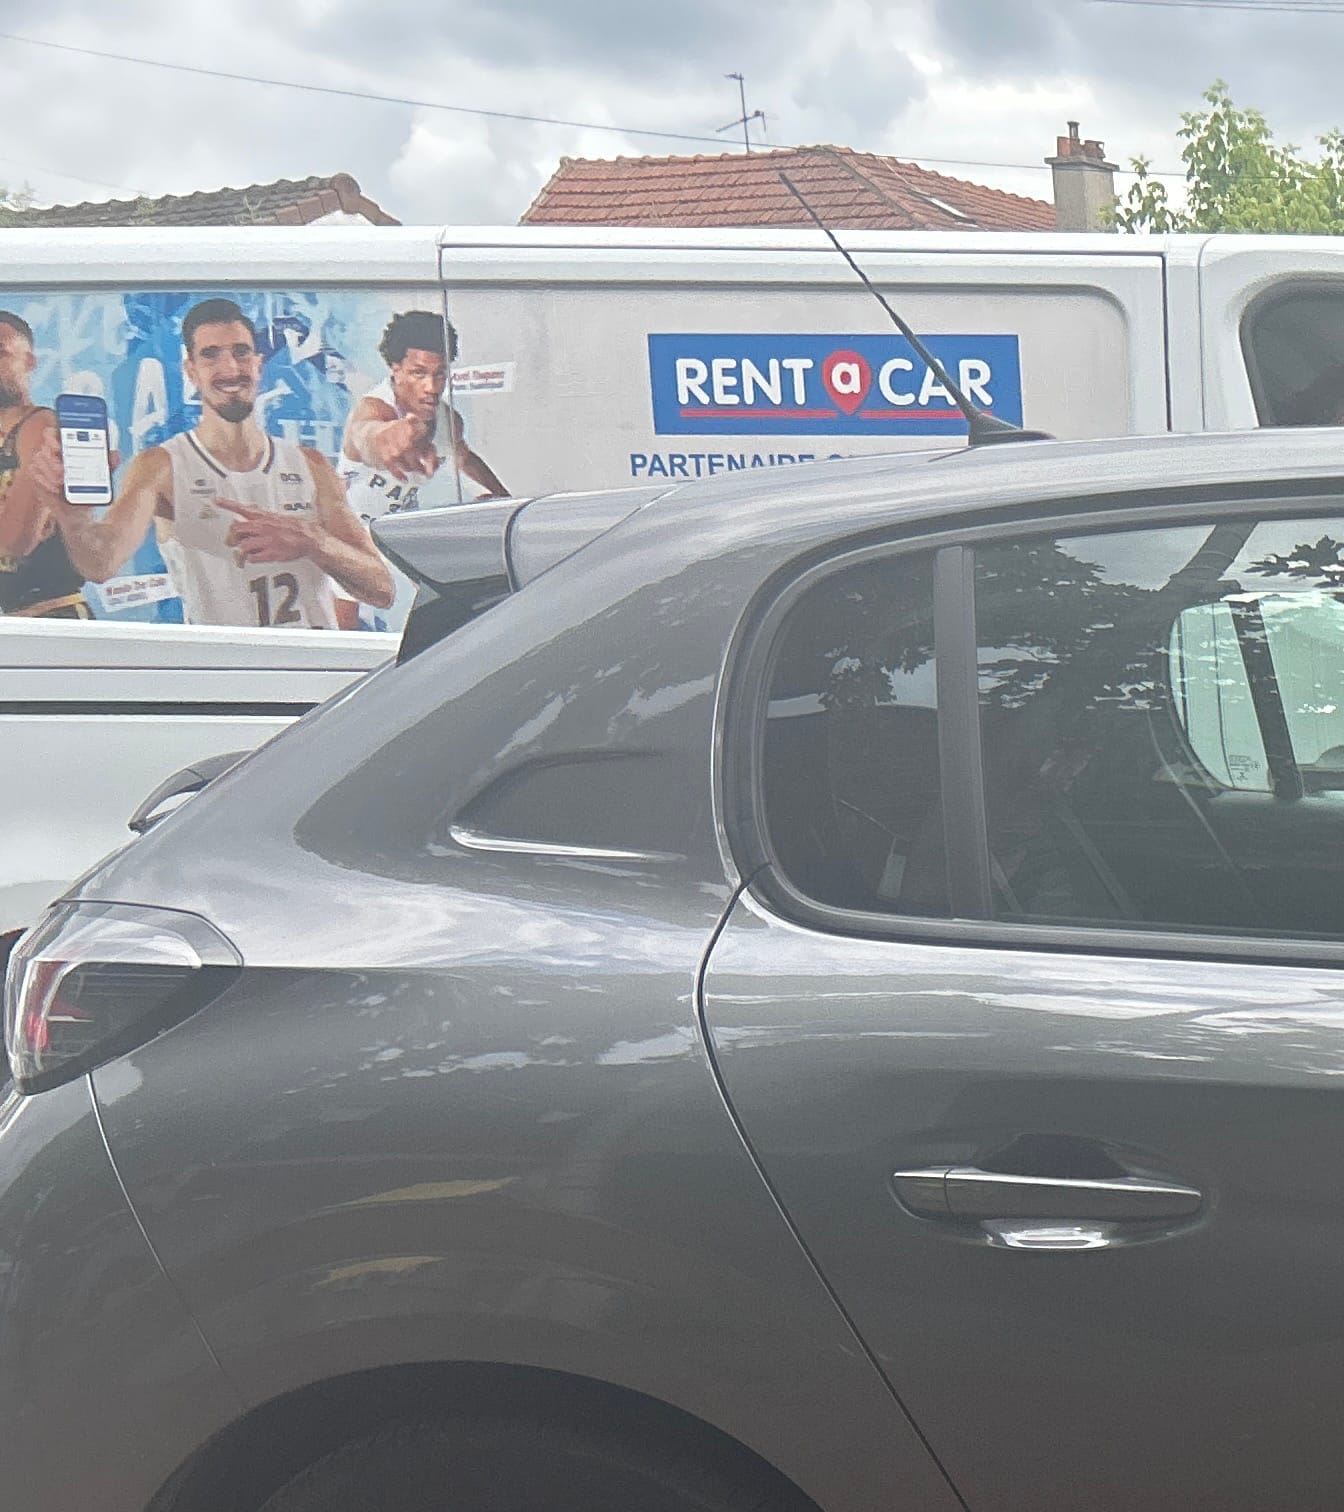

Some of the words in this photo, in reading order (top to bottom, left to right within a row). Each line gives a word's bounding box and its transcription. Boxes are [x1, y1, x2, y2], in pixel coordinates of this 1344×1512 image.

[676, 358, 813, 405] RENT
[831, 362, 862, 394] a
[878, 358, 993, 406] CAR
[249, 572, 301, 627] 12
